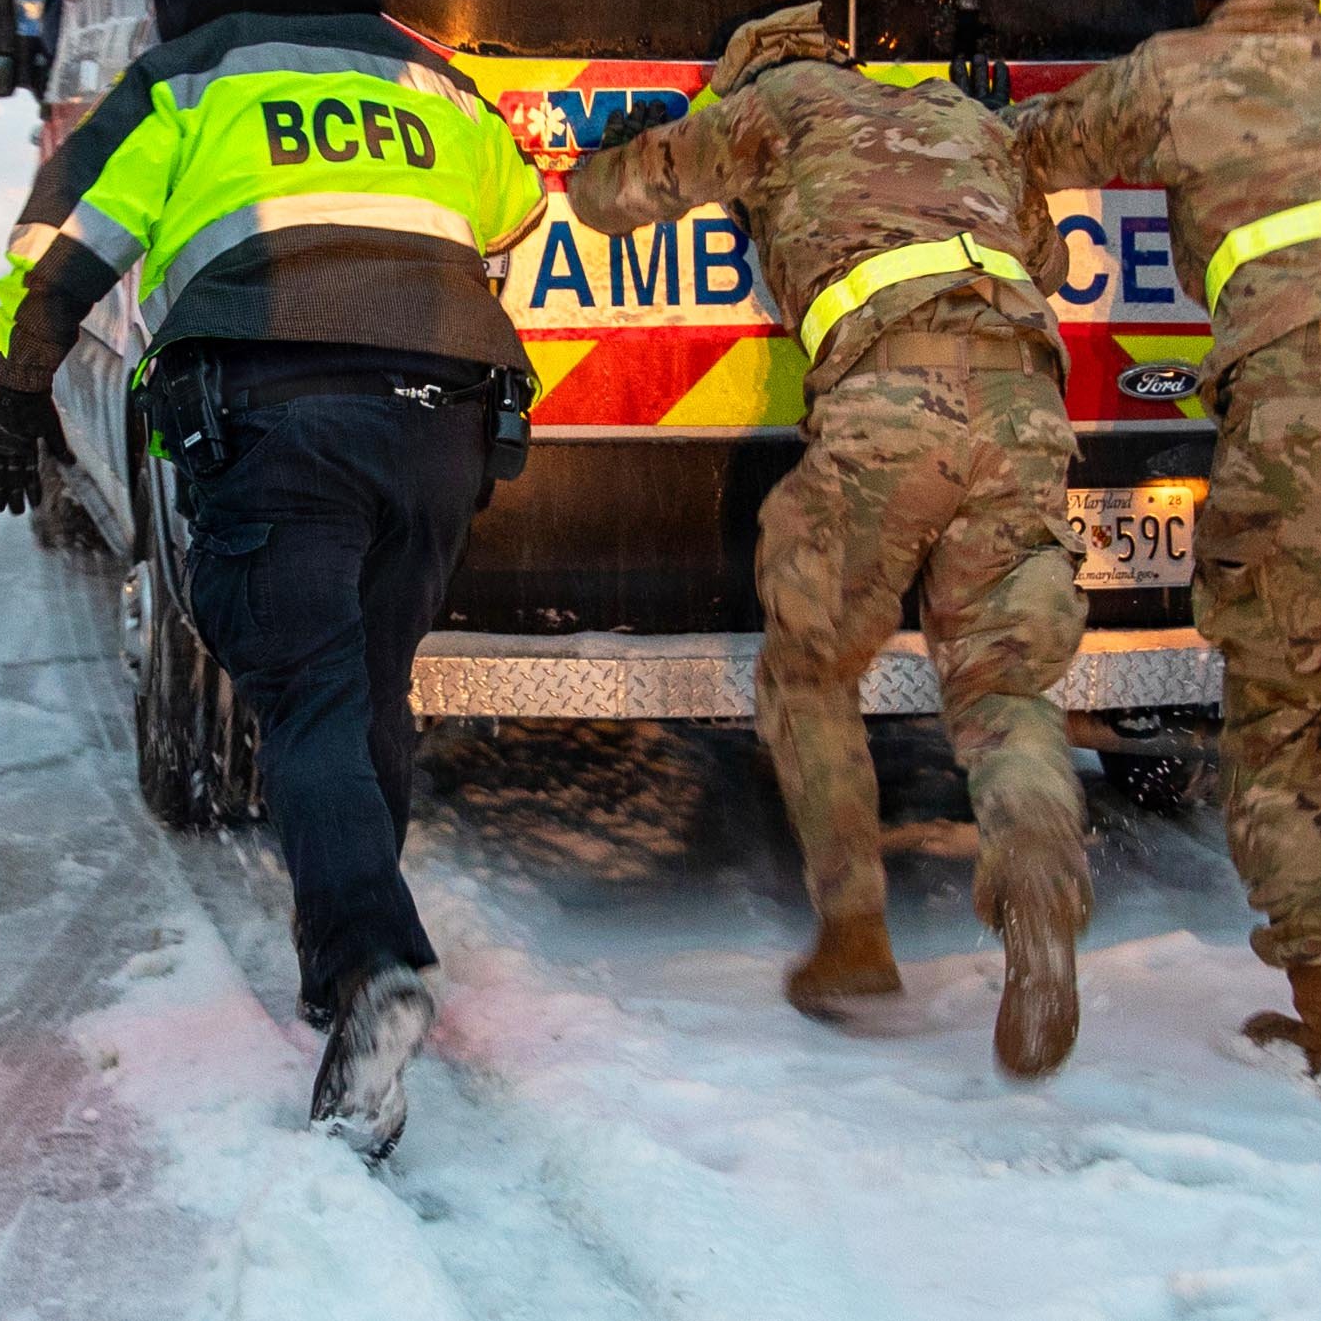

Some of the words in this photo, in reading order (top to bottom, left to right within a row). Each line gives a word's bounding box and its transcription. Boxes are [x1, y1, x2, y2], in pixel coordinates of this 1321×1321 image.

[255, 97, 437, 170] BCFD
[528, 214, 1176, 309] AMBCE
[1136, 371, 1187, 393] Ford
[1068, 490, 1135, 515] Maryland
[1168, 494, 1183, 507] 28
